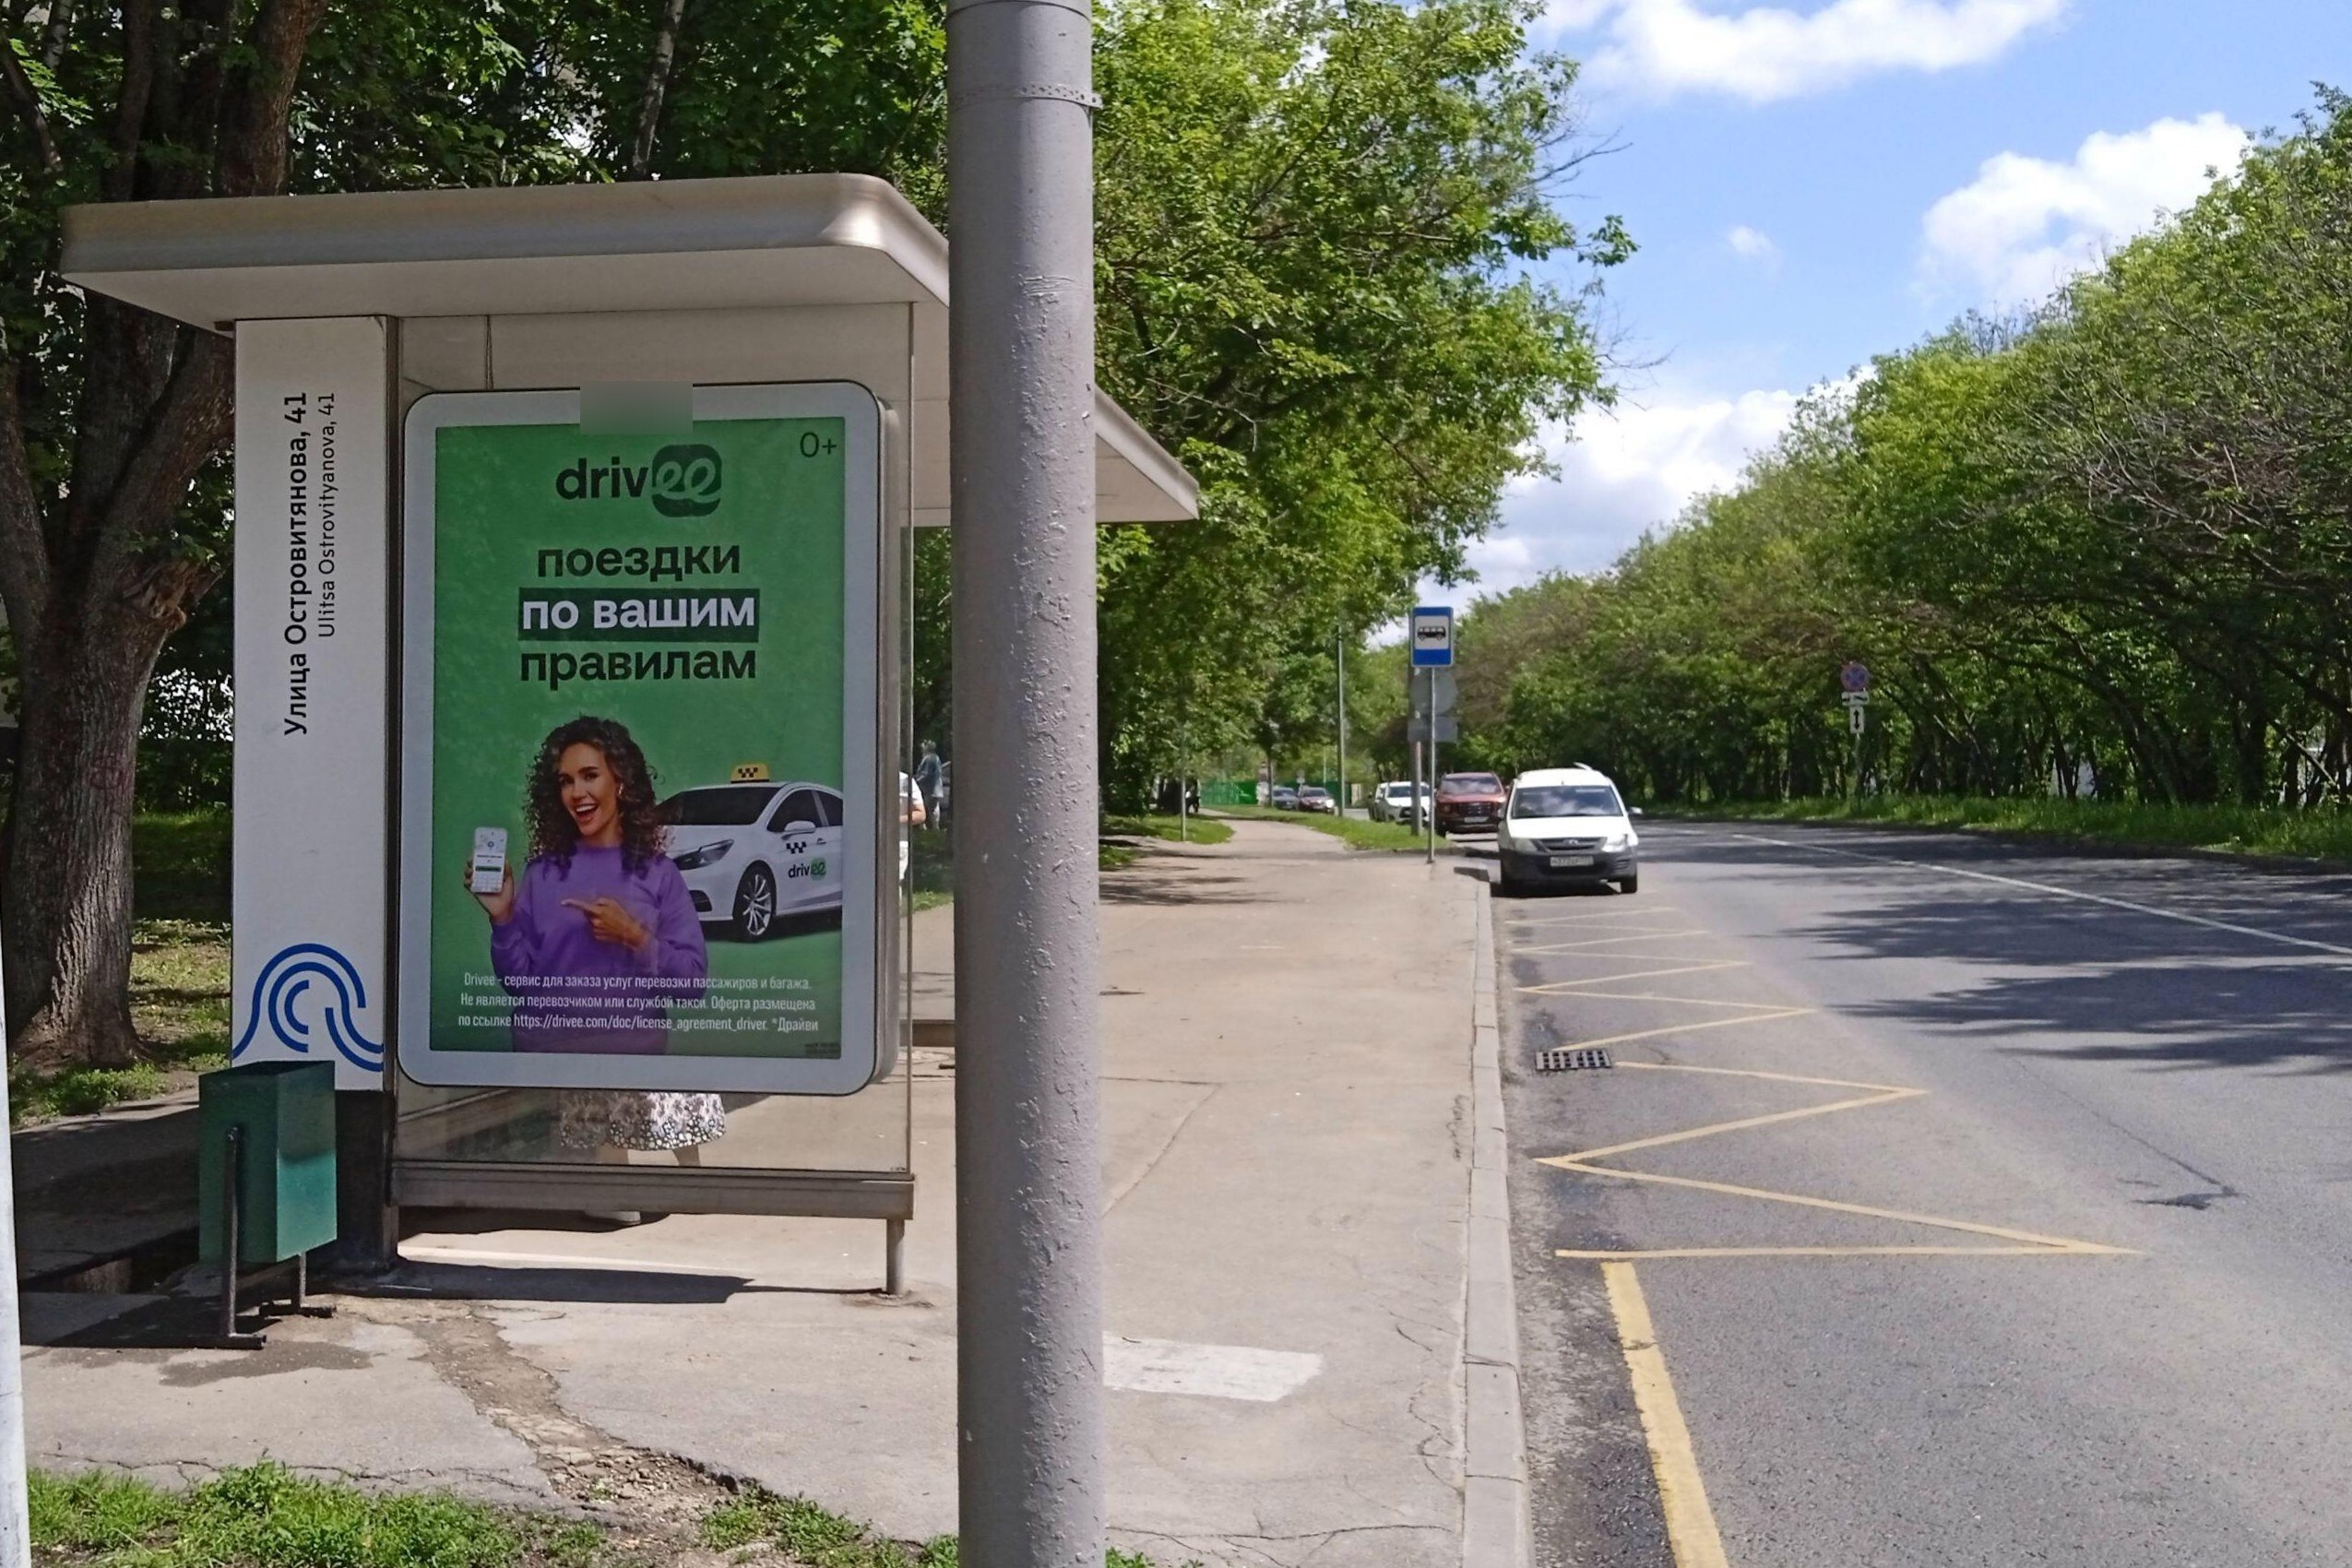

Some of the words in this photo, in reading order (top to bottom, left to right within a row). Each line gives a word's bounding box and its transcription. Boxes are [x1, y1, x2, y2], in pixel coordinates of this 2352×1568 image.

[284, 392, 307, 424] 41
[318, 392, 336, 416] 41
[800, 431, 837, 458] 0+
[555, 455, 722, 504] drivee
[318, 422, 339, 576] Ostrovityanova,
[284, 433, 312, 645] Островитянова,
[537, 545, 740, 582] поездки
[318, 583, 336, 637] Ulitsa
[522, 600, 579, 630] по
[593, 597, 755, 629] вашим
[520, 649, 756, 691] правилам
[284, 653, 310, 736] Улица
[464, 972, 495, 986] Drivee
[505, 975, 540, 989] сервис
[542, 976, 563, 989] для
[565, 977, 600, 987] заказа
[603, 977, 633, 990] услуг
[635, 977, 691, 991] перевозки
[693, 978, 758, 991] пассажиров
[761, 979, 766, 989] и
[769, 977, 812, 990] багажа.
[460, 993, 473, 1004] Не
[476, 996, 525, 1007] является
[528, 997, 602, 1009] перевозчиком
[604, 997, 624, 1008] или
[626, 995, 673, 1011] службой
[675, 998, 708, 1009] такси.
[711, 995, 751, 1011] Оферта
[753, 999, 815, 1012] размещена
[458, 1016, 470, 1026] по
[472, 1016, 511, 1027] ссылке
